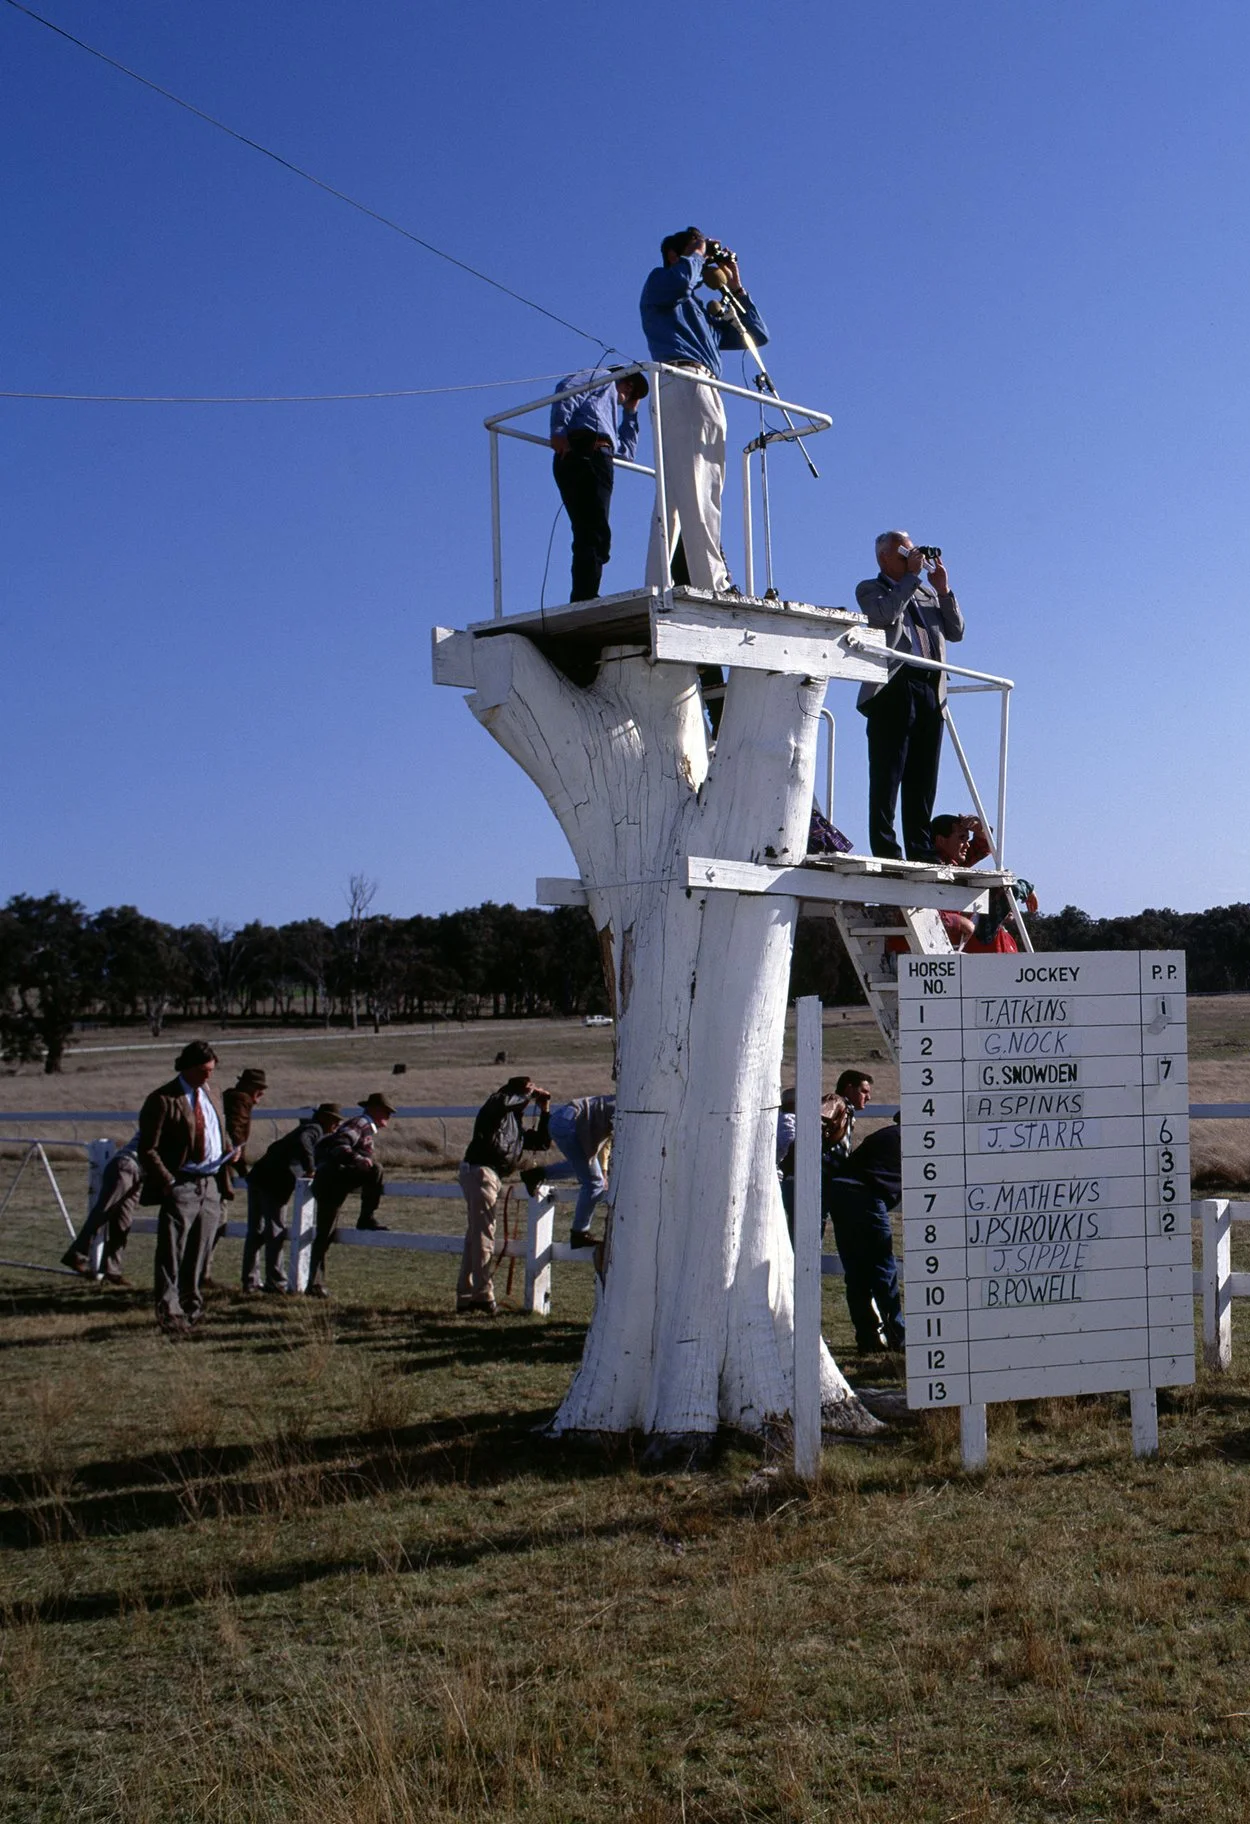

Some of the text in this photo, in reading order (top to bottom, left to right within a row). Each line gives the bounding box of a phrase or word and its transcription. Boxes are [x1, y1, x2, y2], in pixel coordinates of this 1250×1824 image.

[909, 962, 955, 977] HORSE
[1016, 967, 1080, 983] JOCKEY
[924, 980, 947, 994] NO.
[919, 1006, 924, 1023] 1
[921, 1038, 932, 1055] 2
[985, 1031, 1067, 1054] G.NOCK
[922, 1069, 933, 1086] 3
[1161, 1061, 1172, 1079] 7
[922, 1100, 934, 1116] 4
[924, 1131, 935, 1148] 5
[1160, 1120, 1172, 1143] 6
[1161, 1153, 1174, 1172] 3
[924, 1163, 936, 1180] 6
[1163, 1181, 1175, 1202] 5
[924, 1195, 936, 1212] 7
[1164, 1214, 1174, 1232] 2
[925, 1225, 936, 1242] 8
[927, 1256, 938, 1273] 9
[926, 1287, 944, 1305] 10
[927, 1318, 941, 1336] 11
[928, 1351, 944, 1369] 12
[929, 1382, 947, 1400] 13
